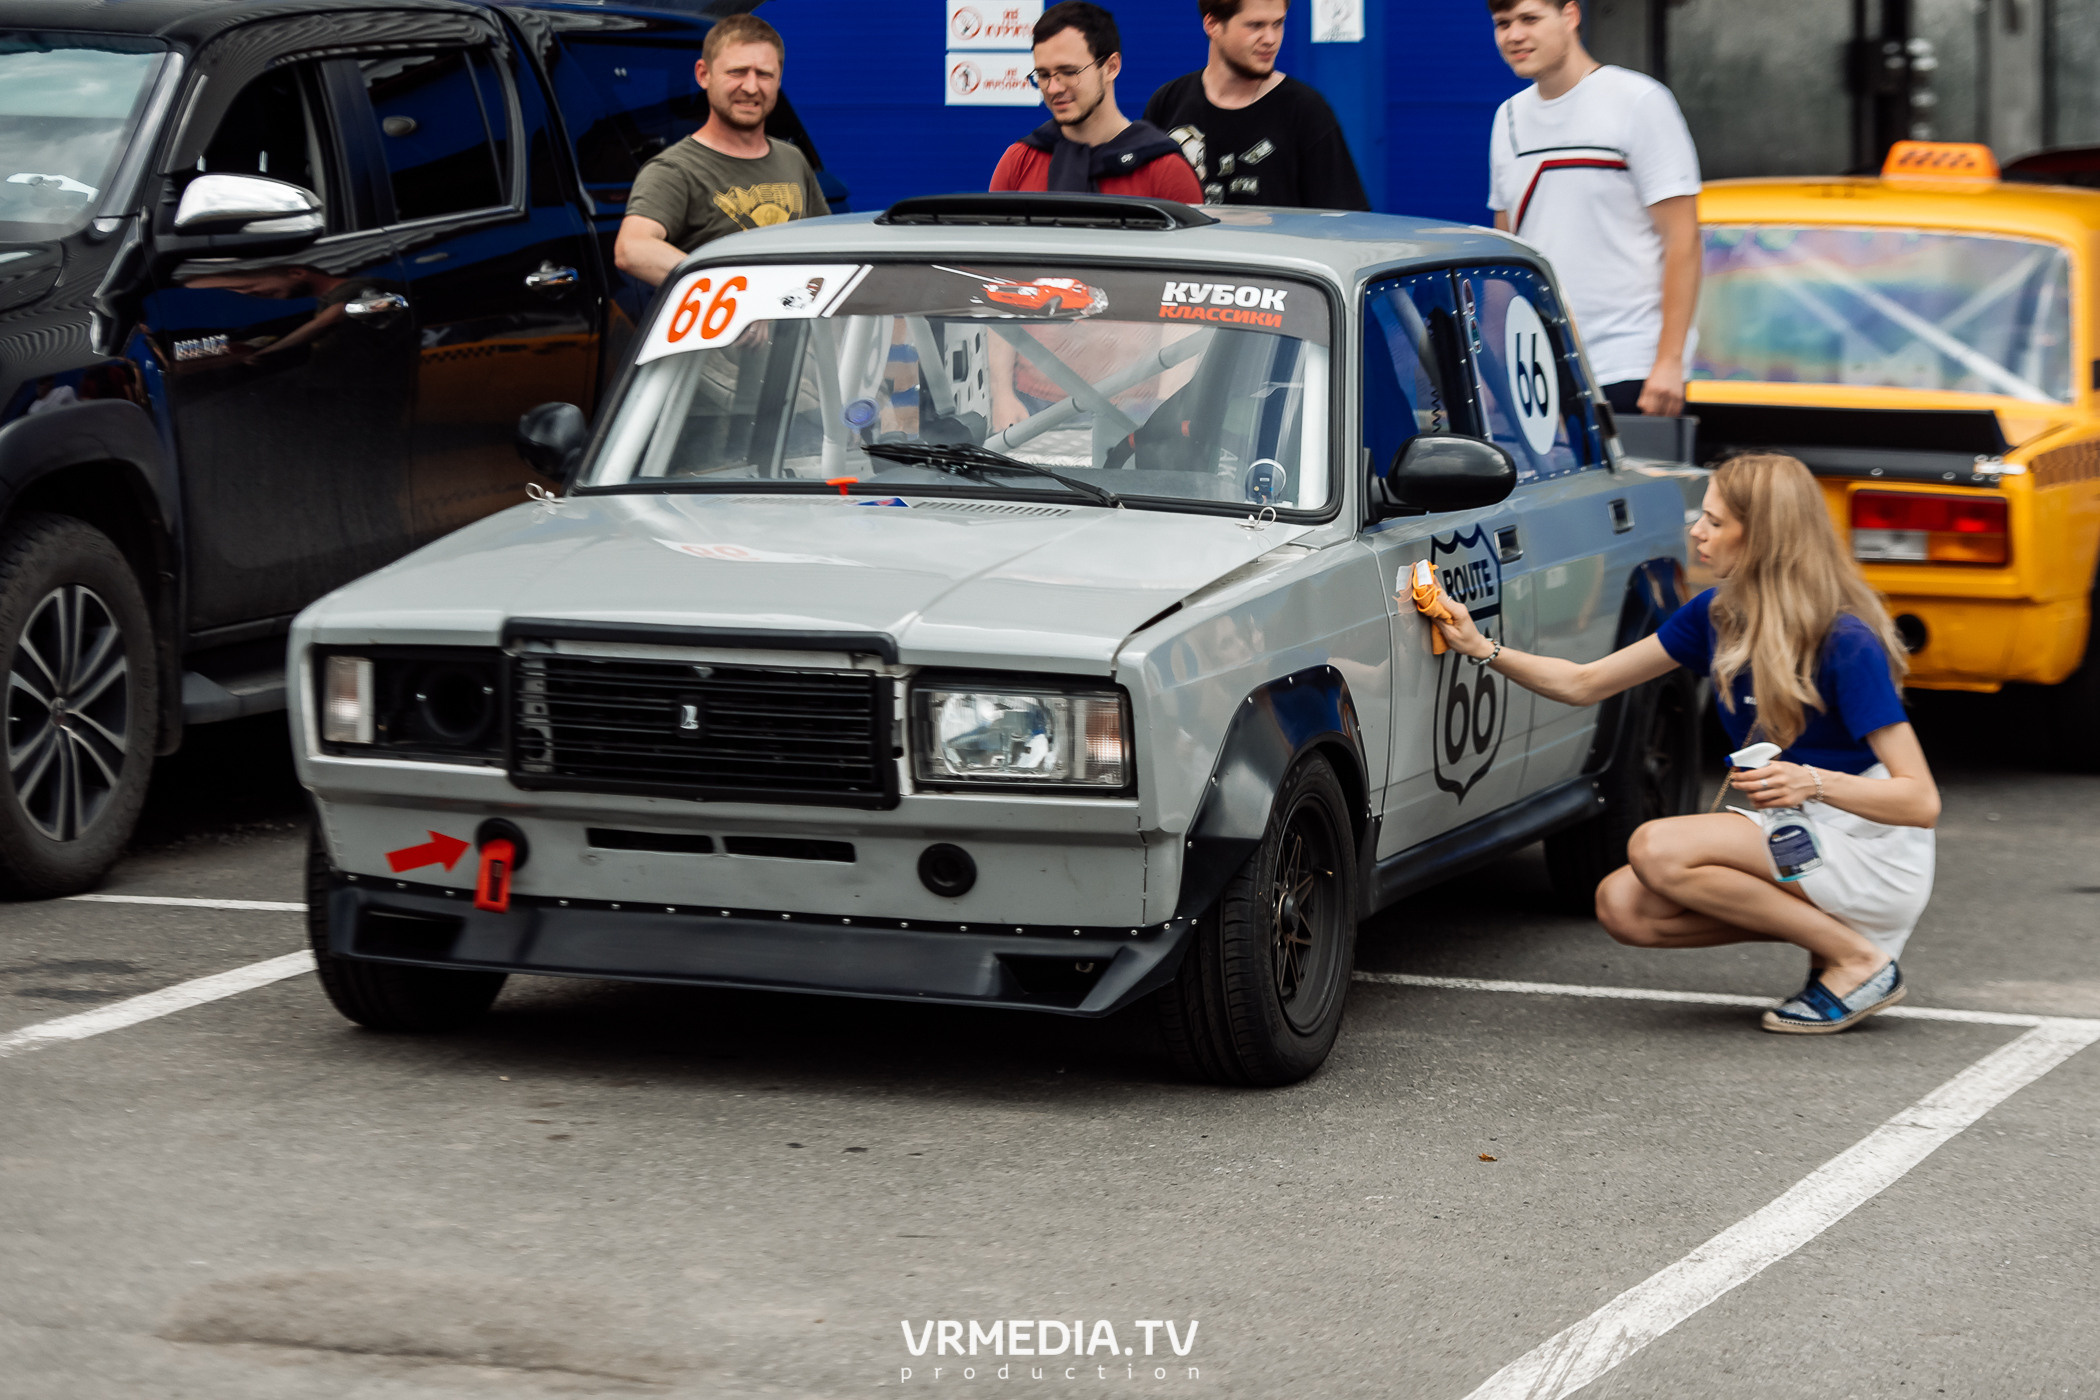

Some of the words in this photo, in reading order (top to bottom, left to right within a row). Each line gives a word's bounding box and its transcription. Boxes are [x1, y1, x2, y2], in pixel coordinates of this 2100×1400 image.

[667, 275, 748, 344] 66
[1158, 304, 1284, 328] КЛАССИКИ
[1161, 281, 1289, 312] КУБОК
[1515, 332, 1549, 418] 66
[1441, 558, 1494, 605] ROUTE
[1445, 626, 1497, 765] 66
